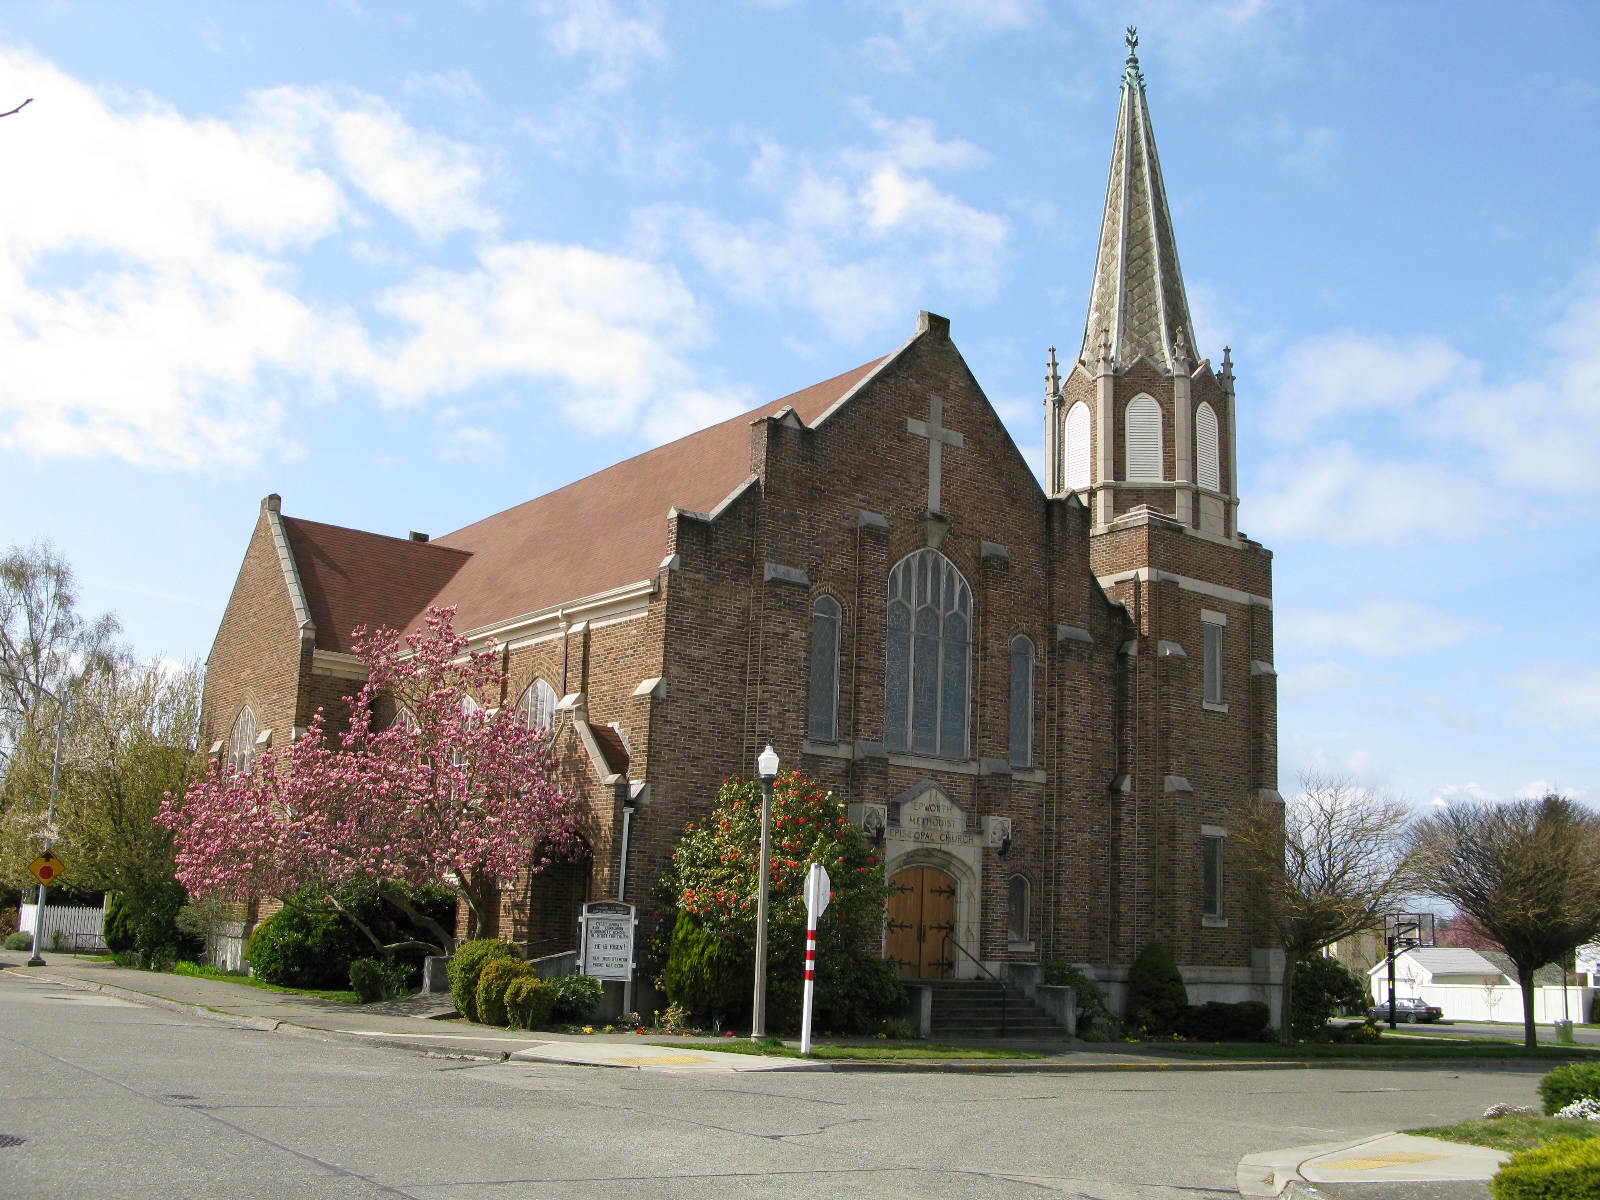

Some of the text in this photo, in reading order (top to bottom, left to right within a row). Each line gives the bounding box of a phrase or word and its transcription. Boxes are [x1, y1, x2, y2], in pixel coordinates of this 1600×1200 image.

[913, 801, 952, 812] EPWORTH
[909, 816, 955, 828] METHODIST
[890, 828, 974, 844] EPISCOPAL CHURCH
